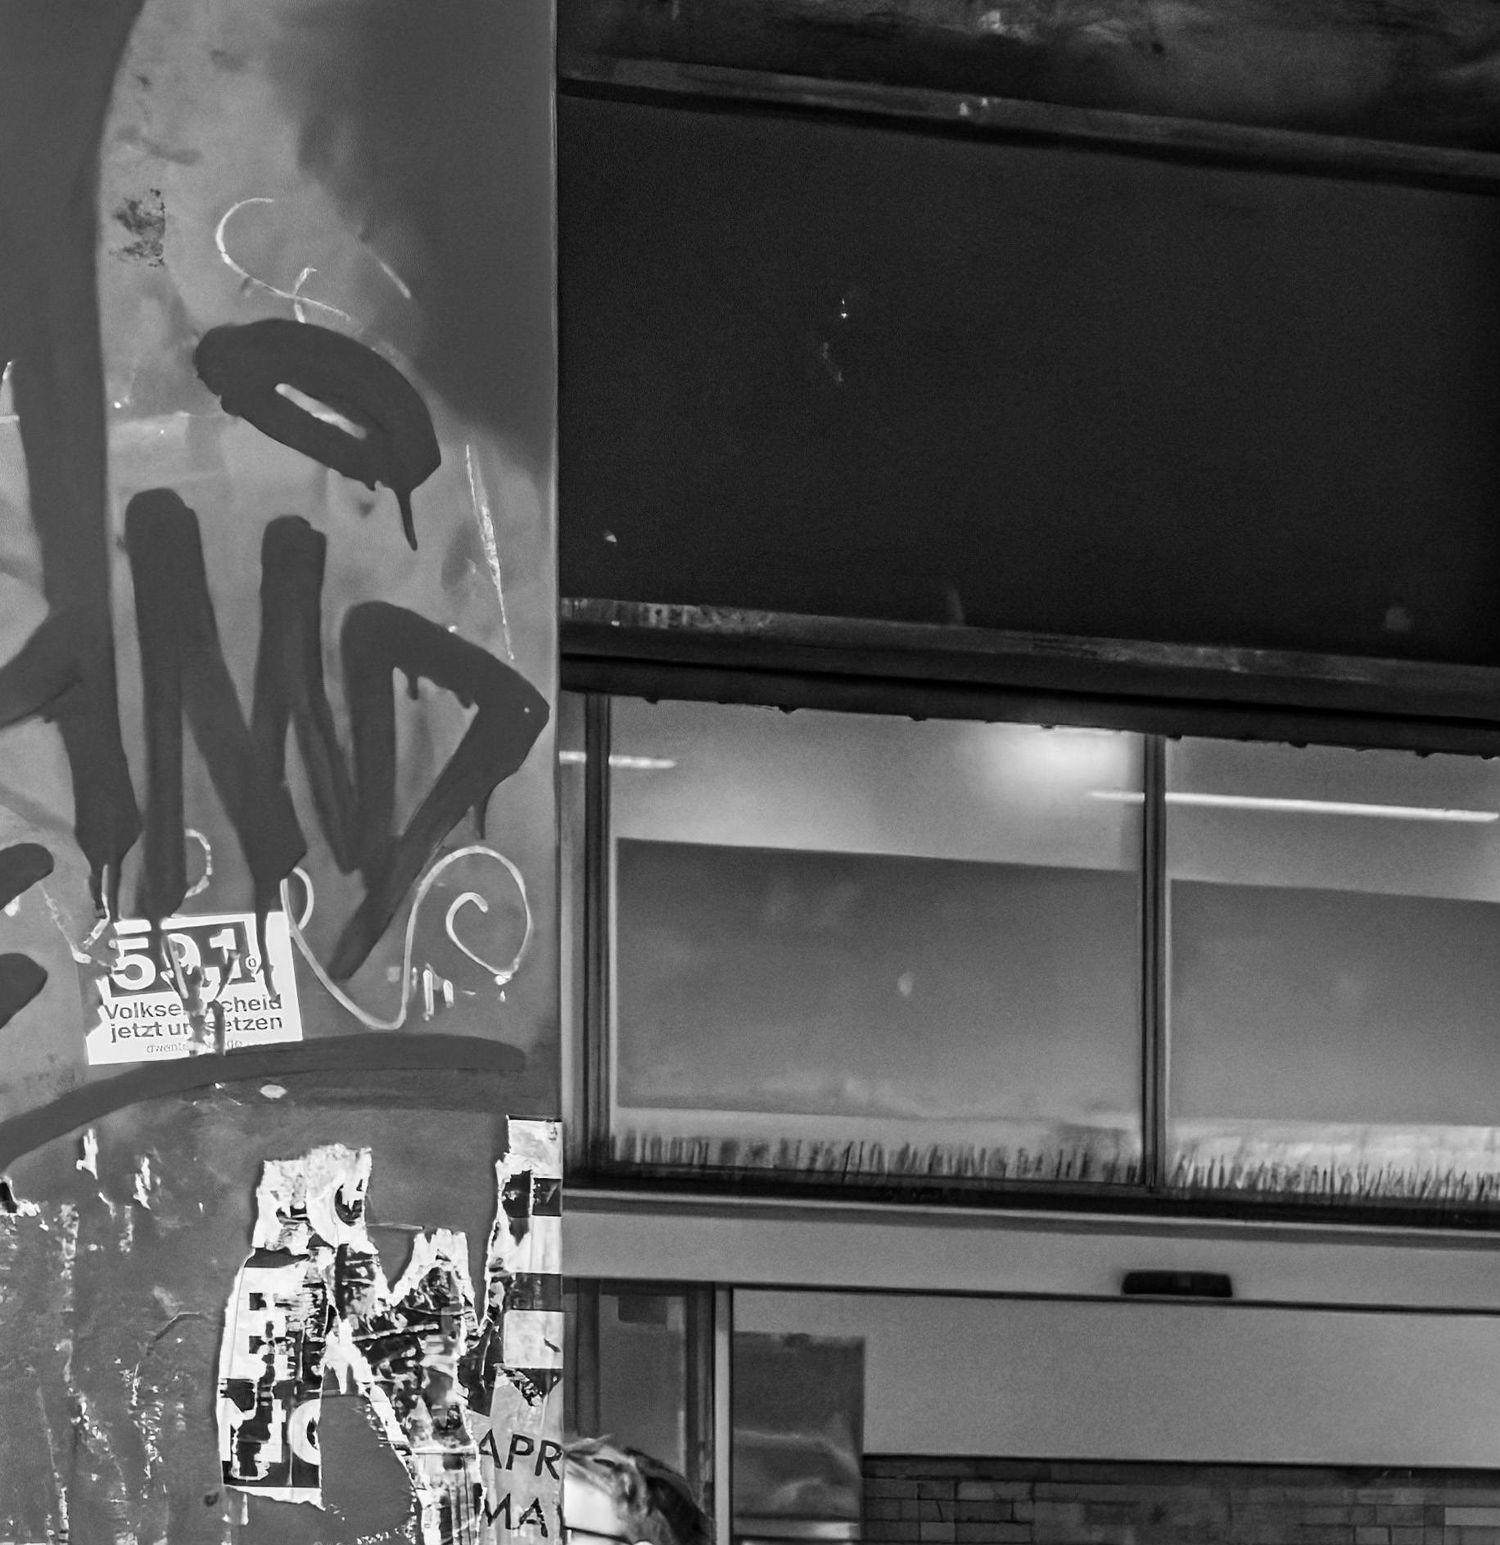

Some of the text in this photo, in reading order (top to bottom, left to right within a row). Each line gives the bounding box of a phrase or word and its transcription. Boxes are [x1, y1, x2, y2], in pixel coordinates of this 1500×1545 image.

[104, 995, 283, 1020] Volksecheid
[110, 1014, 283, 1044] jetzt uetzen
